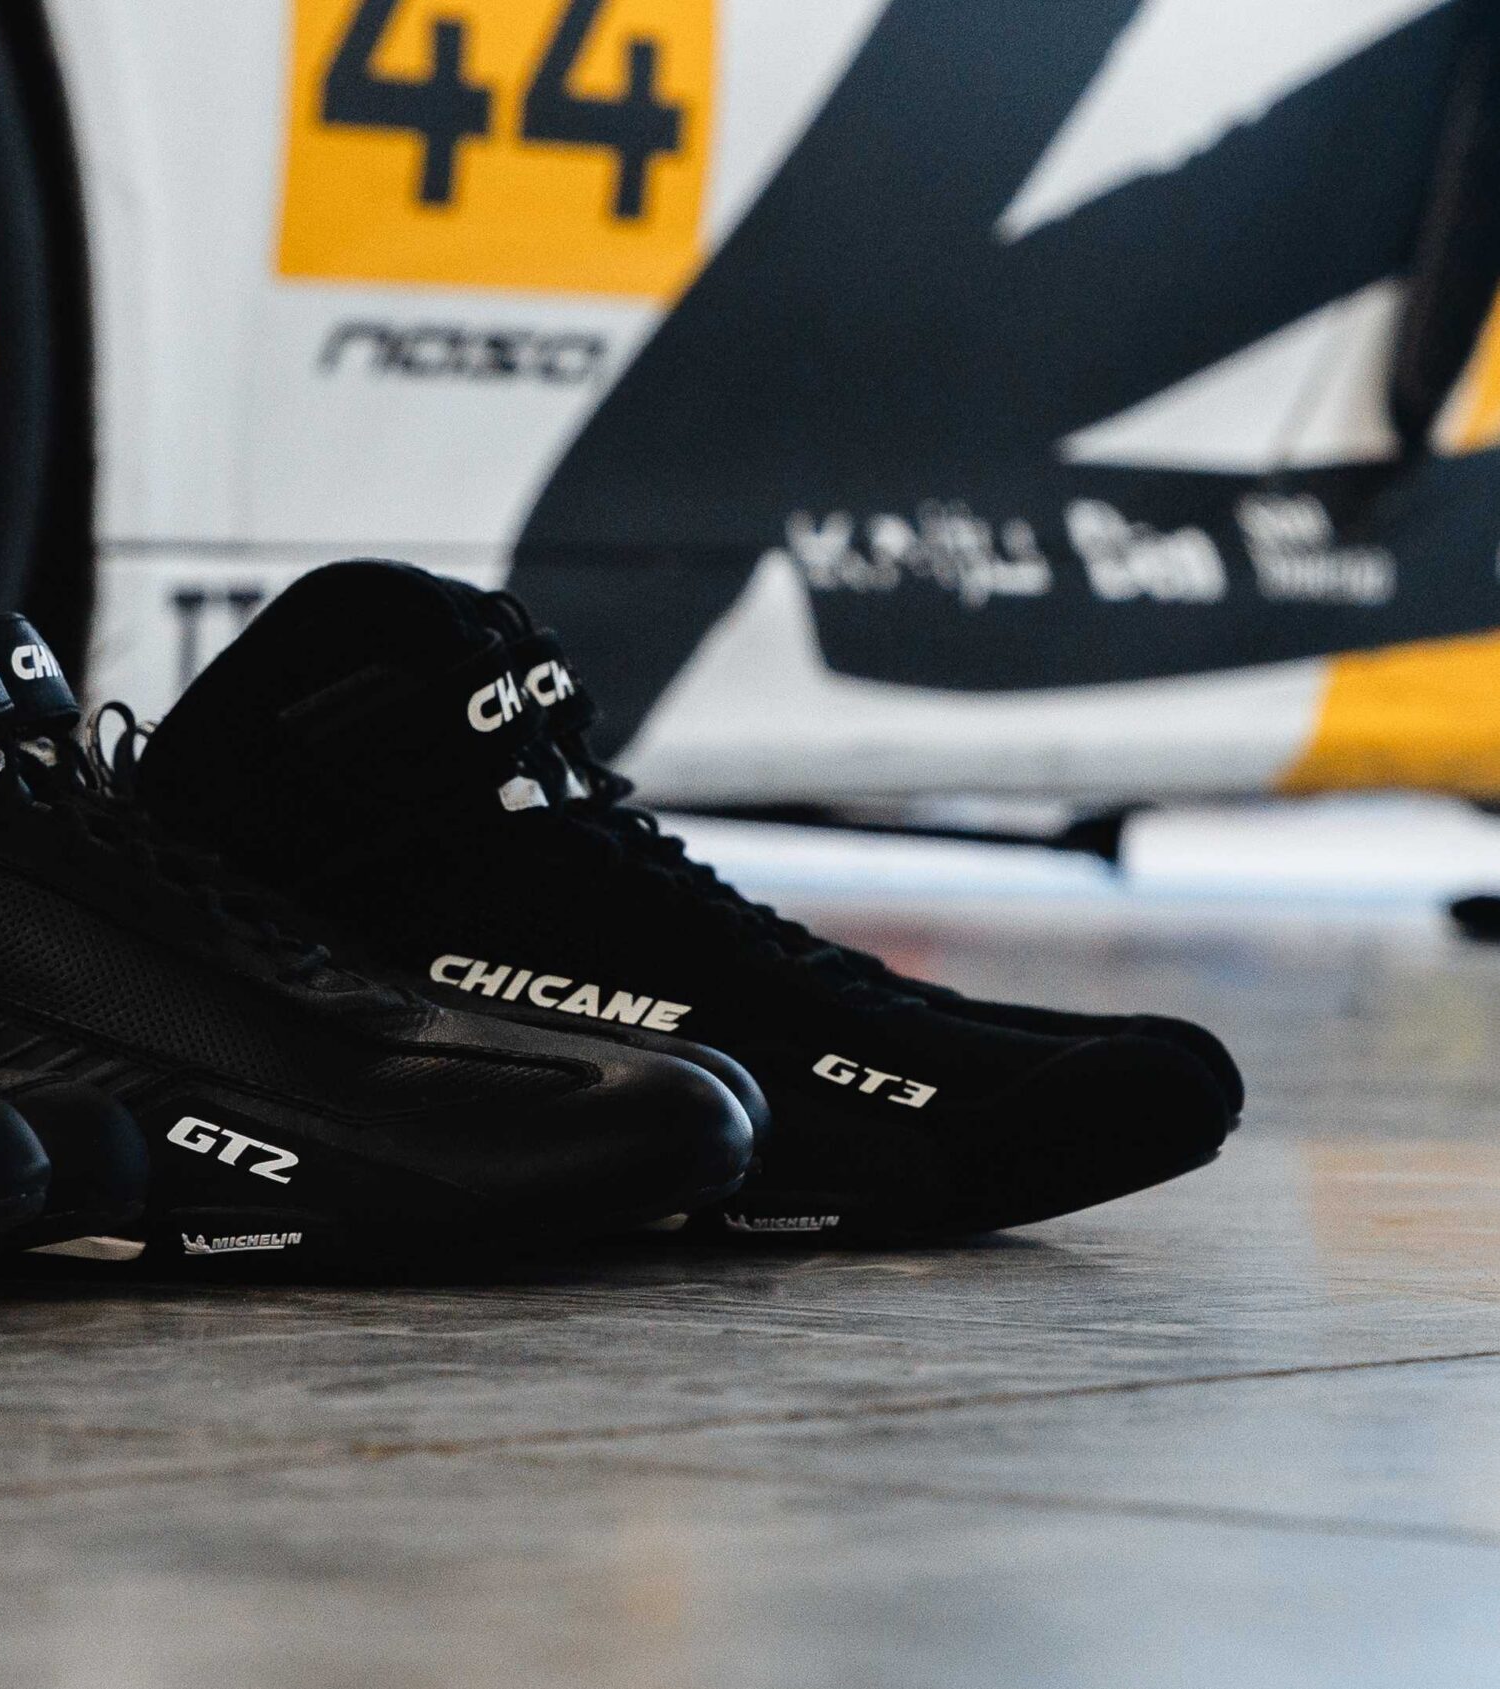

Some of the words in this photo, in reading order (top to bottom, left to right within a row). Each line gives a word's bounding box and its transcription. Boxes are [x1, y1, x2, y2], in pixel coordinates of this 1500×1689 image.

[320, 0, 681, 220] 44
[430, 955, 692, 1031] CHICANE
[812, 1054, 938, 1108] GT3
[167, 1117, 299, 1185] GT2
[211, 1232, 303, 1249] MICHELIN
[752, 1215, 840, 1228] MICHELIN
